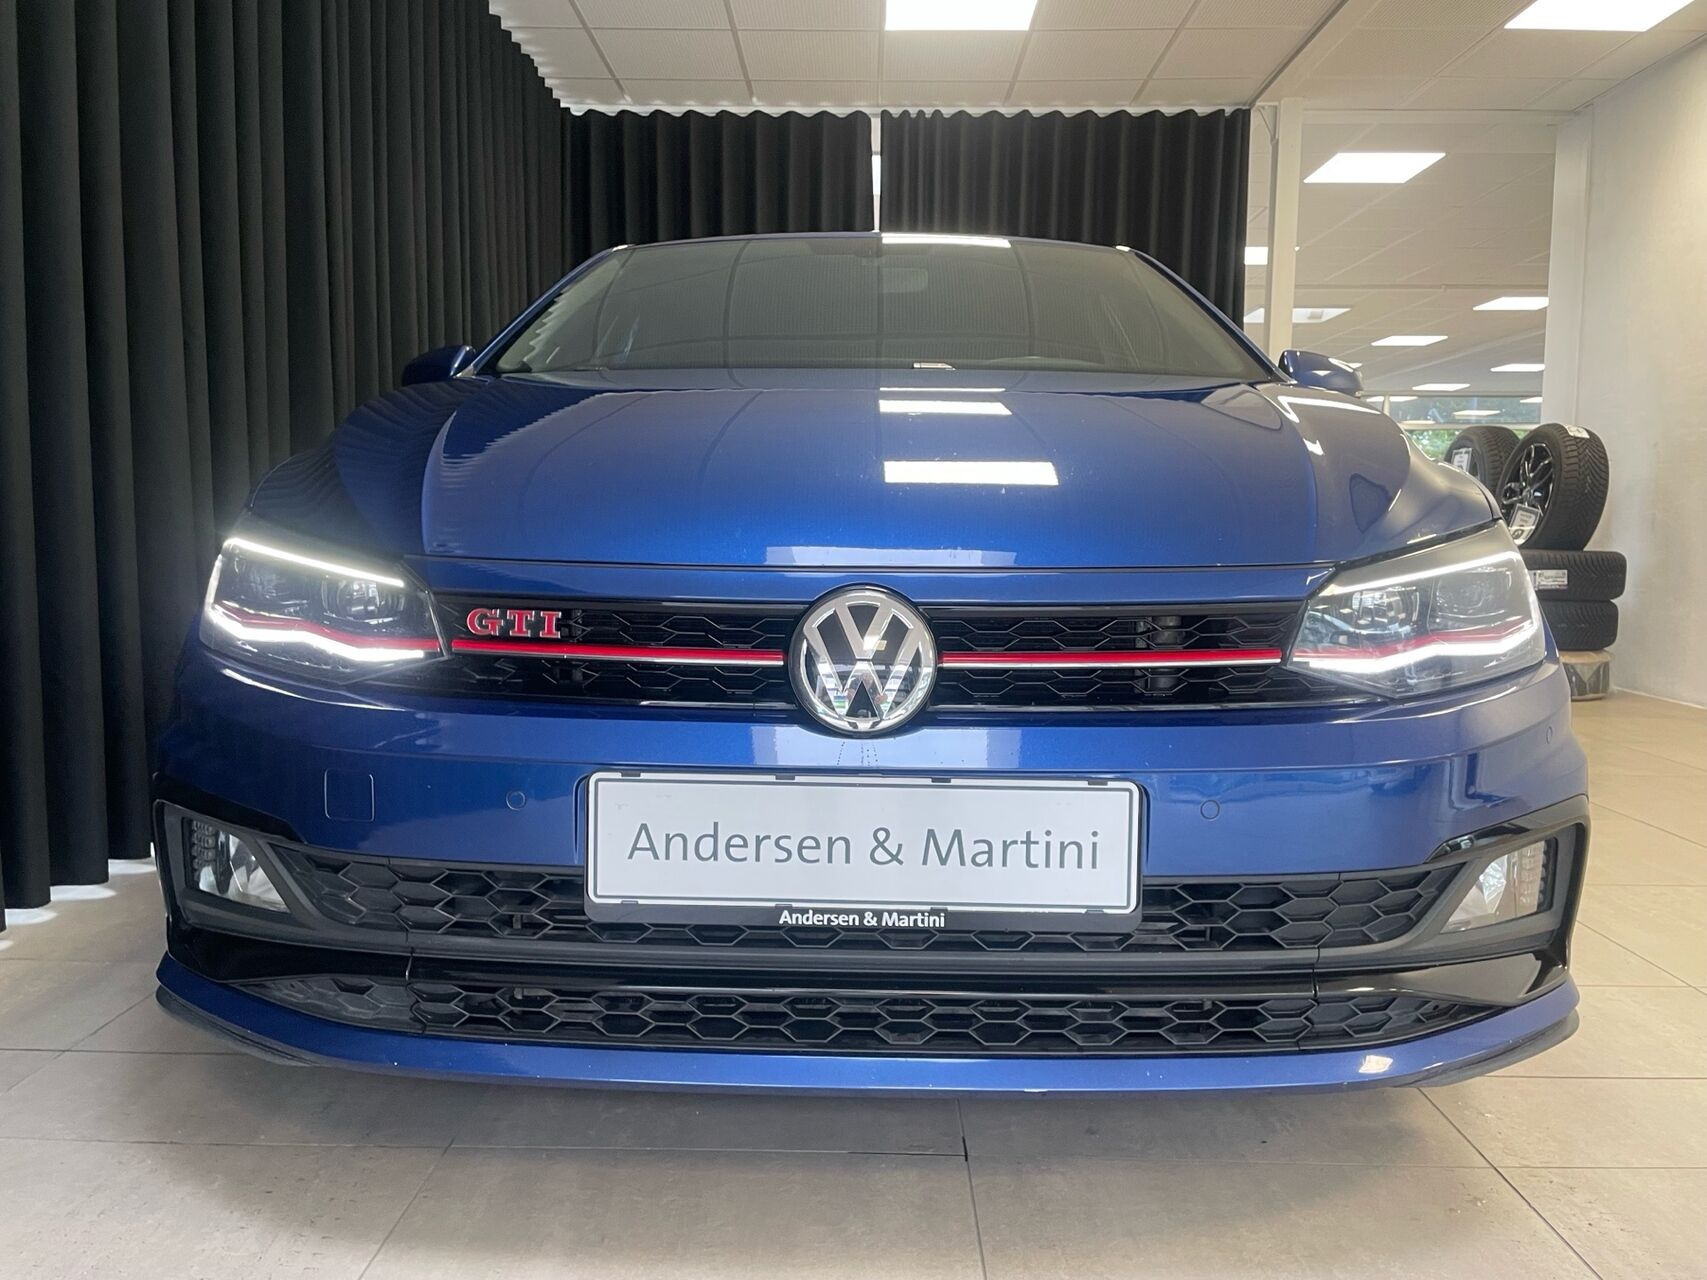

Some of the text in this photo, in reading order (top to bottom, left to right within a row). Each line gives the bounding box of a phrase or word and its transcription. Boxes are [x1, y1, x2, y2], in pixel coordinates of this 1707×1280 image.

[466, 607, 562, 639] GTI
[627, 821, 1101, 870] Andersen & Martini
[778, 908, 946, 928] Andersen & Martini
